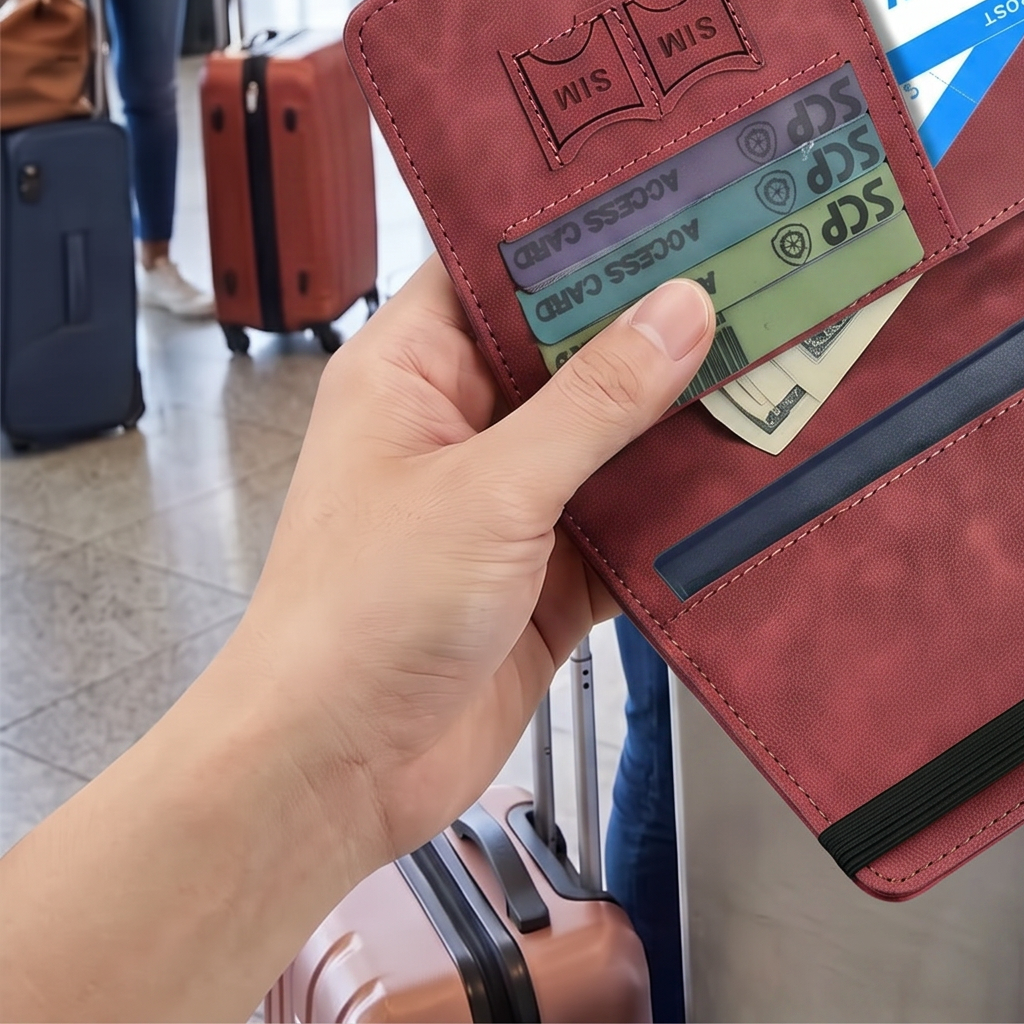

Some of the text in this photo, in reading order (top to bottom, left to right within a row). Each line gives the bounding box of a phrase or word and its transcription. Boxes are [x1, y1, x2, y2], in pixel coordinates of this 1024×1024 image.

[658, 16, 717, 59] SIM
[553, 67, 613, 111] SIM
[788, 77, 862, 144] SCP
[806, 125, 881, 195] SCP
[514, 168, 680, 270] ACCESS CARD
[821, 176, 896, 246] SCP
[535, 272, 604, 323] CARD
